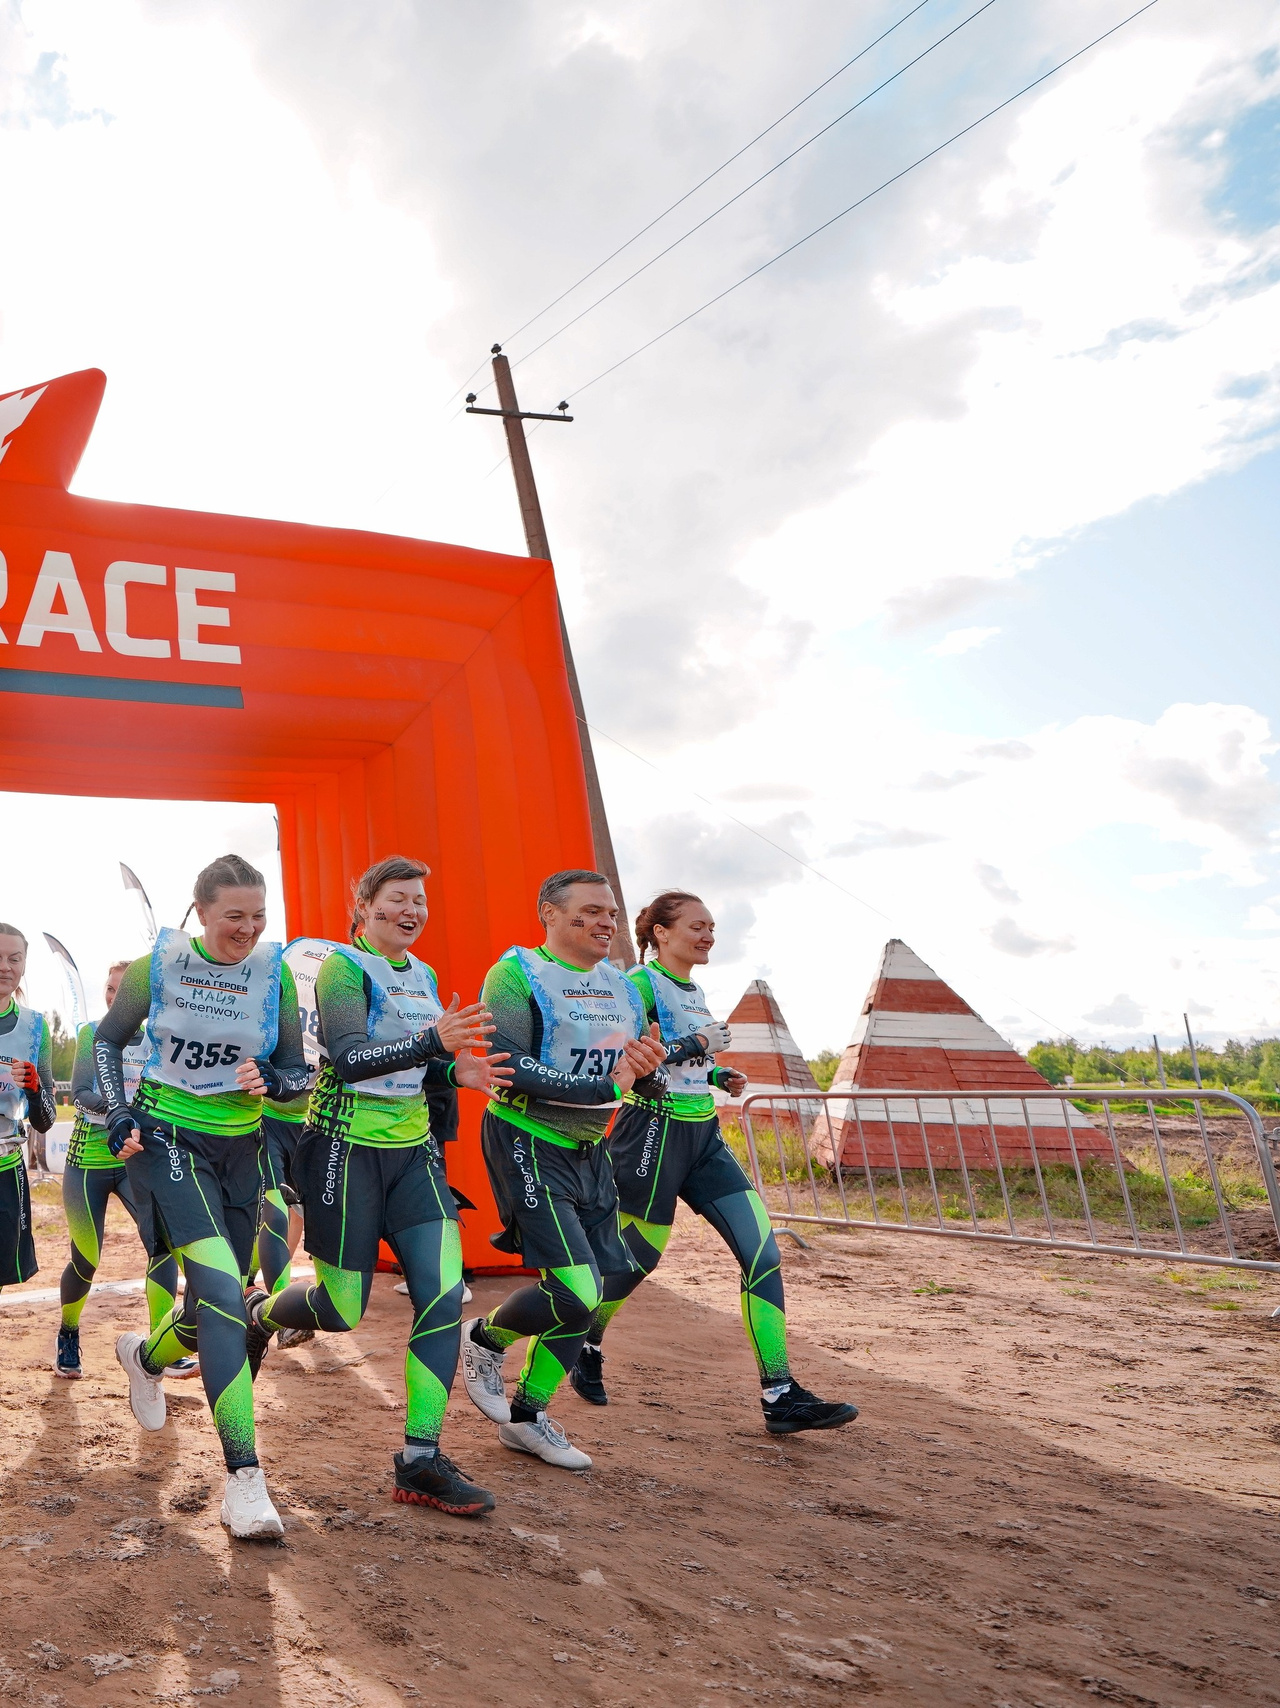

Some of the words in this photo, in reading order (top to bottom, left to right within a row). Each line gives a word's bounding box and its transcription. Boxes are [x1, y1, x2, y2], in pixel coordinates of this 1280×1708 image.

[175, 952, 190, 970] 4
[241, 964, 252, 983] 4
[180, 975, 211, 986] ГОНКА
[213, 980, 248, 993] ГЕРОЕВ
[192, 987, 237, 1005] МАЙЯ
[175, 997, 241, 1020] Greenway
[569, 1011, 620, 1023] Greenway
[170, 1035, 241, 1070] 7355
[372, 1053, 410, 1067] GLOBAL
[570, 1048, 624, 1077] 737
[636, 1123, 659, 1178] Greenway
[322, 1138, 341, 1206] Greenwa
